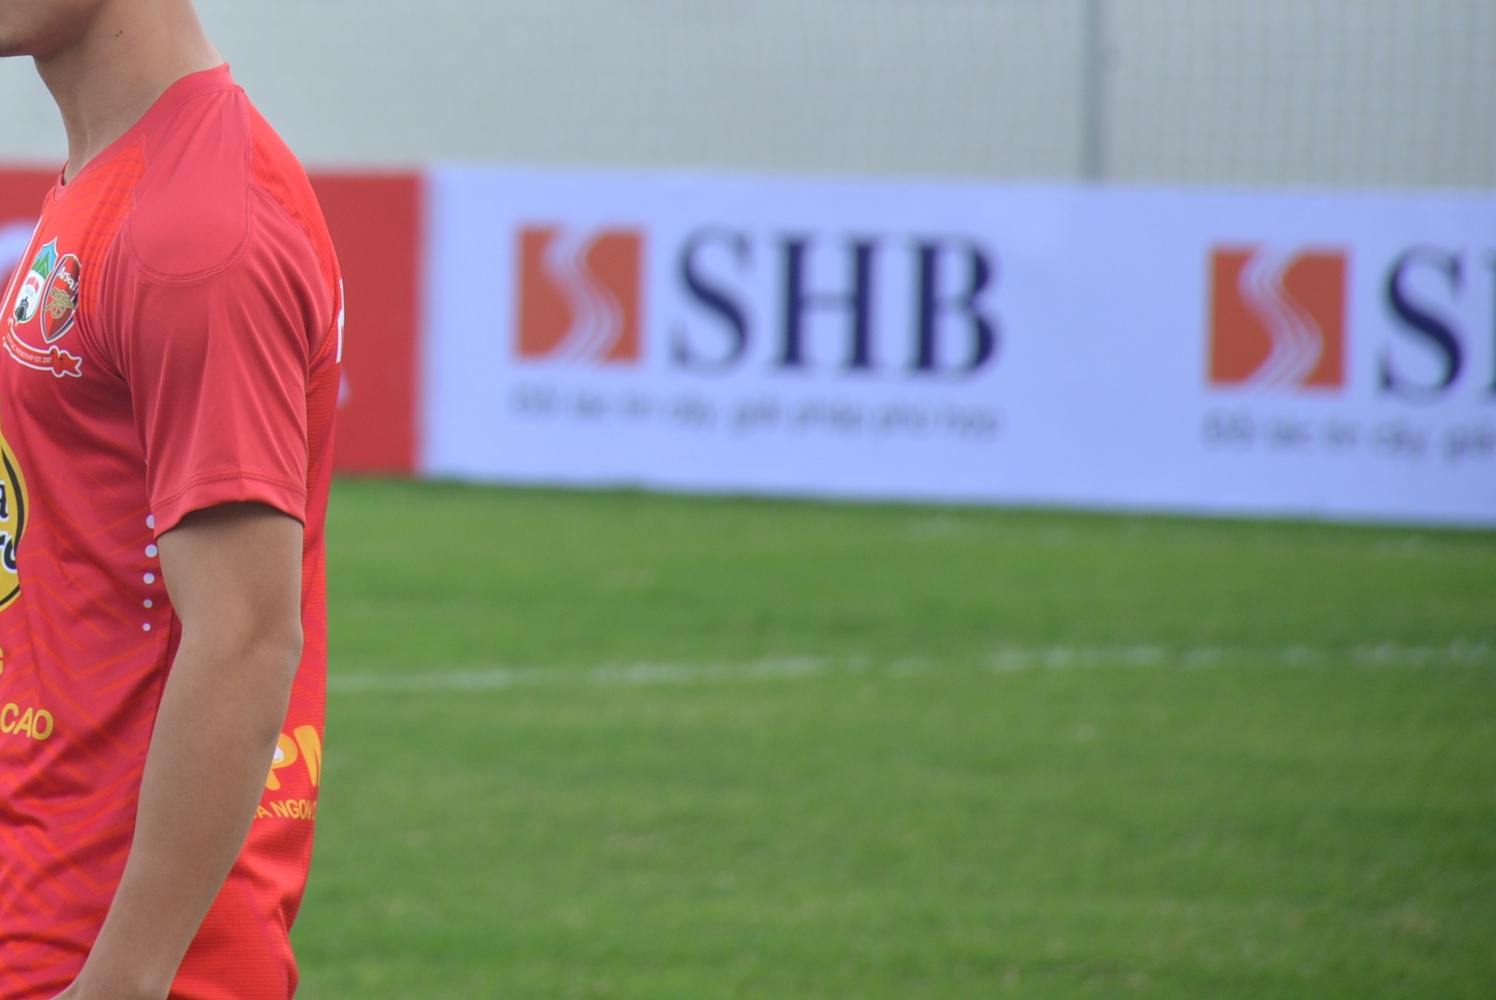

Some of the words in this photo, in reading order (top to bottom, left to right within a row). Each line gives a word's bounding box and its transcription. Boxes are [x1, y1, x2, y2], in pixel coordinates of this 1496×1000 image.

[670, 224, 1005, 382] SHB
[1377, 243, 1496, 405] S
[0, 702, 54, 740] CAO
